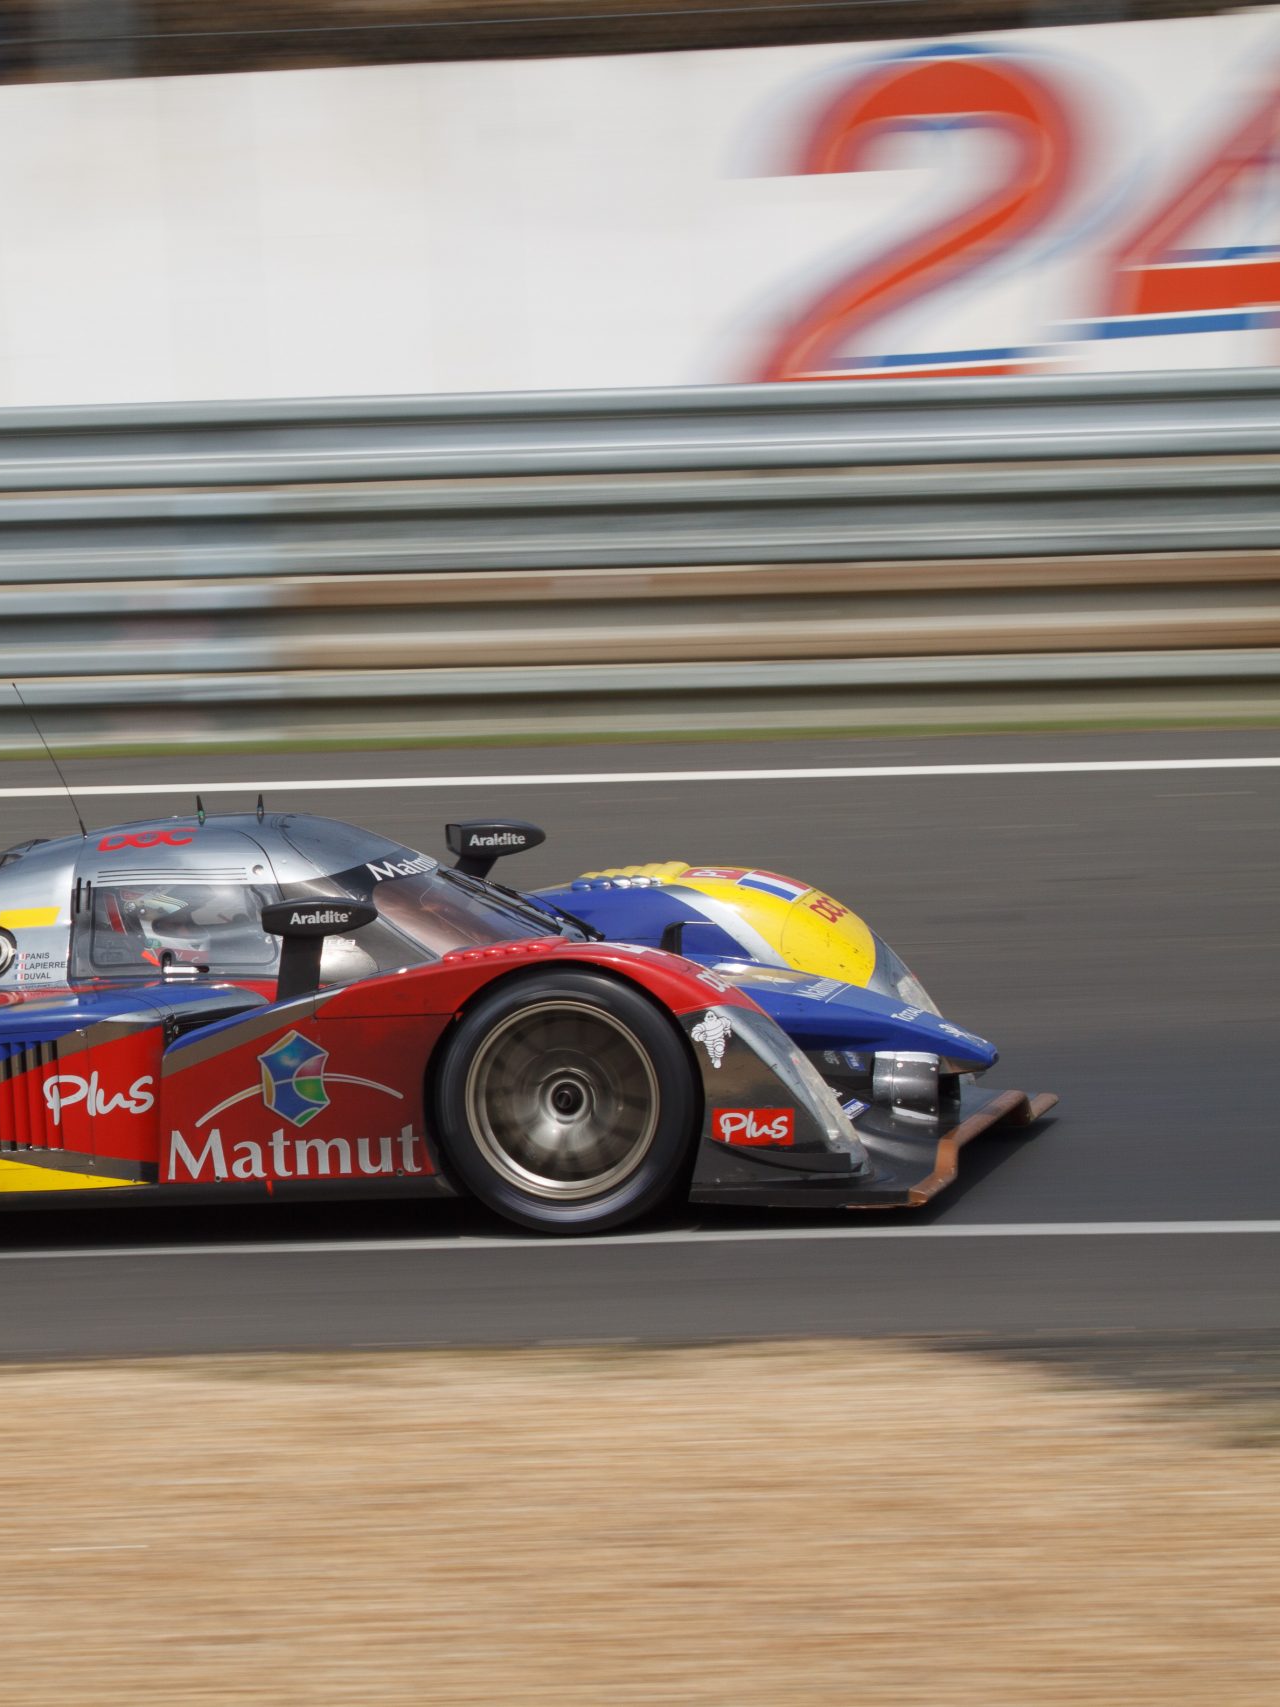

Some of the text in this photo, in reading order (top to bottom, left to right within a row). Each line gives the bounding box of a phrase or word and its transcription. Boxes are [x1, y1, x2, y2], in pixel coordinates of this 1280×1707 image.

[96, 827, 198, 852] DOC
[469, 832, 526, 847] Araldite
[290, 910, 350, 925] Araldite
[809, 897, 848, 923] DOC
[24, 961, 67, 970] LAPIERRE
[25, 952, 50, 960] PANIS
[24, 972, 52, 980] DUVAL
[43, 1071, 155, 1125] Plus
[719, 1111, 789, 1142] Plus
[168, 1124, 422, 1180] Matmut
